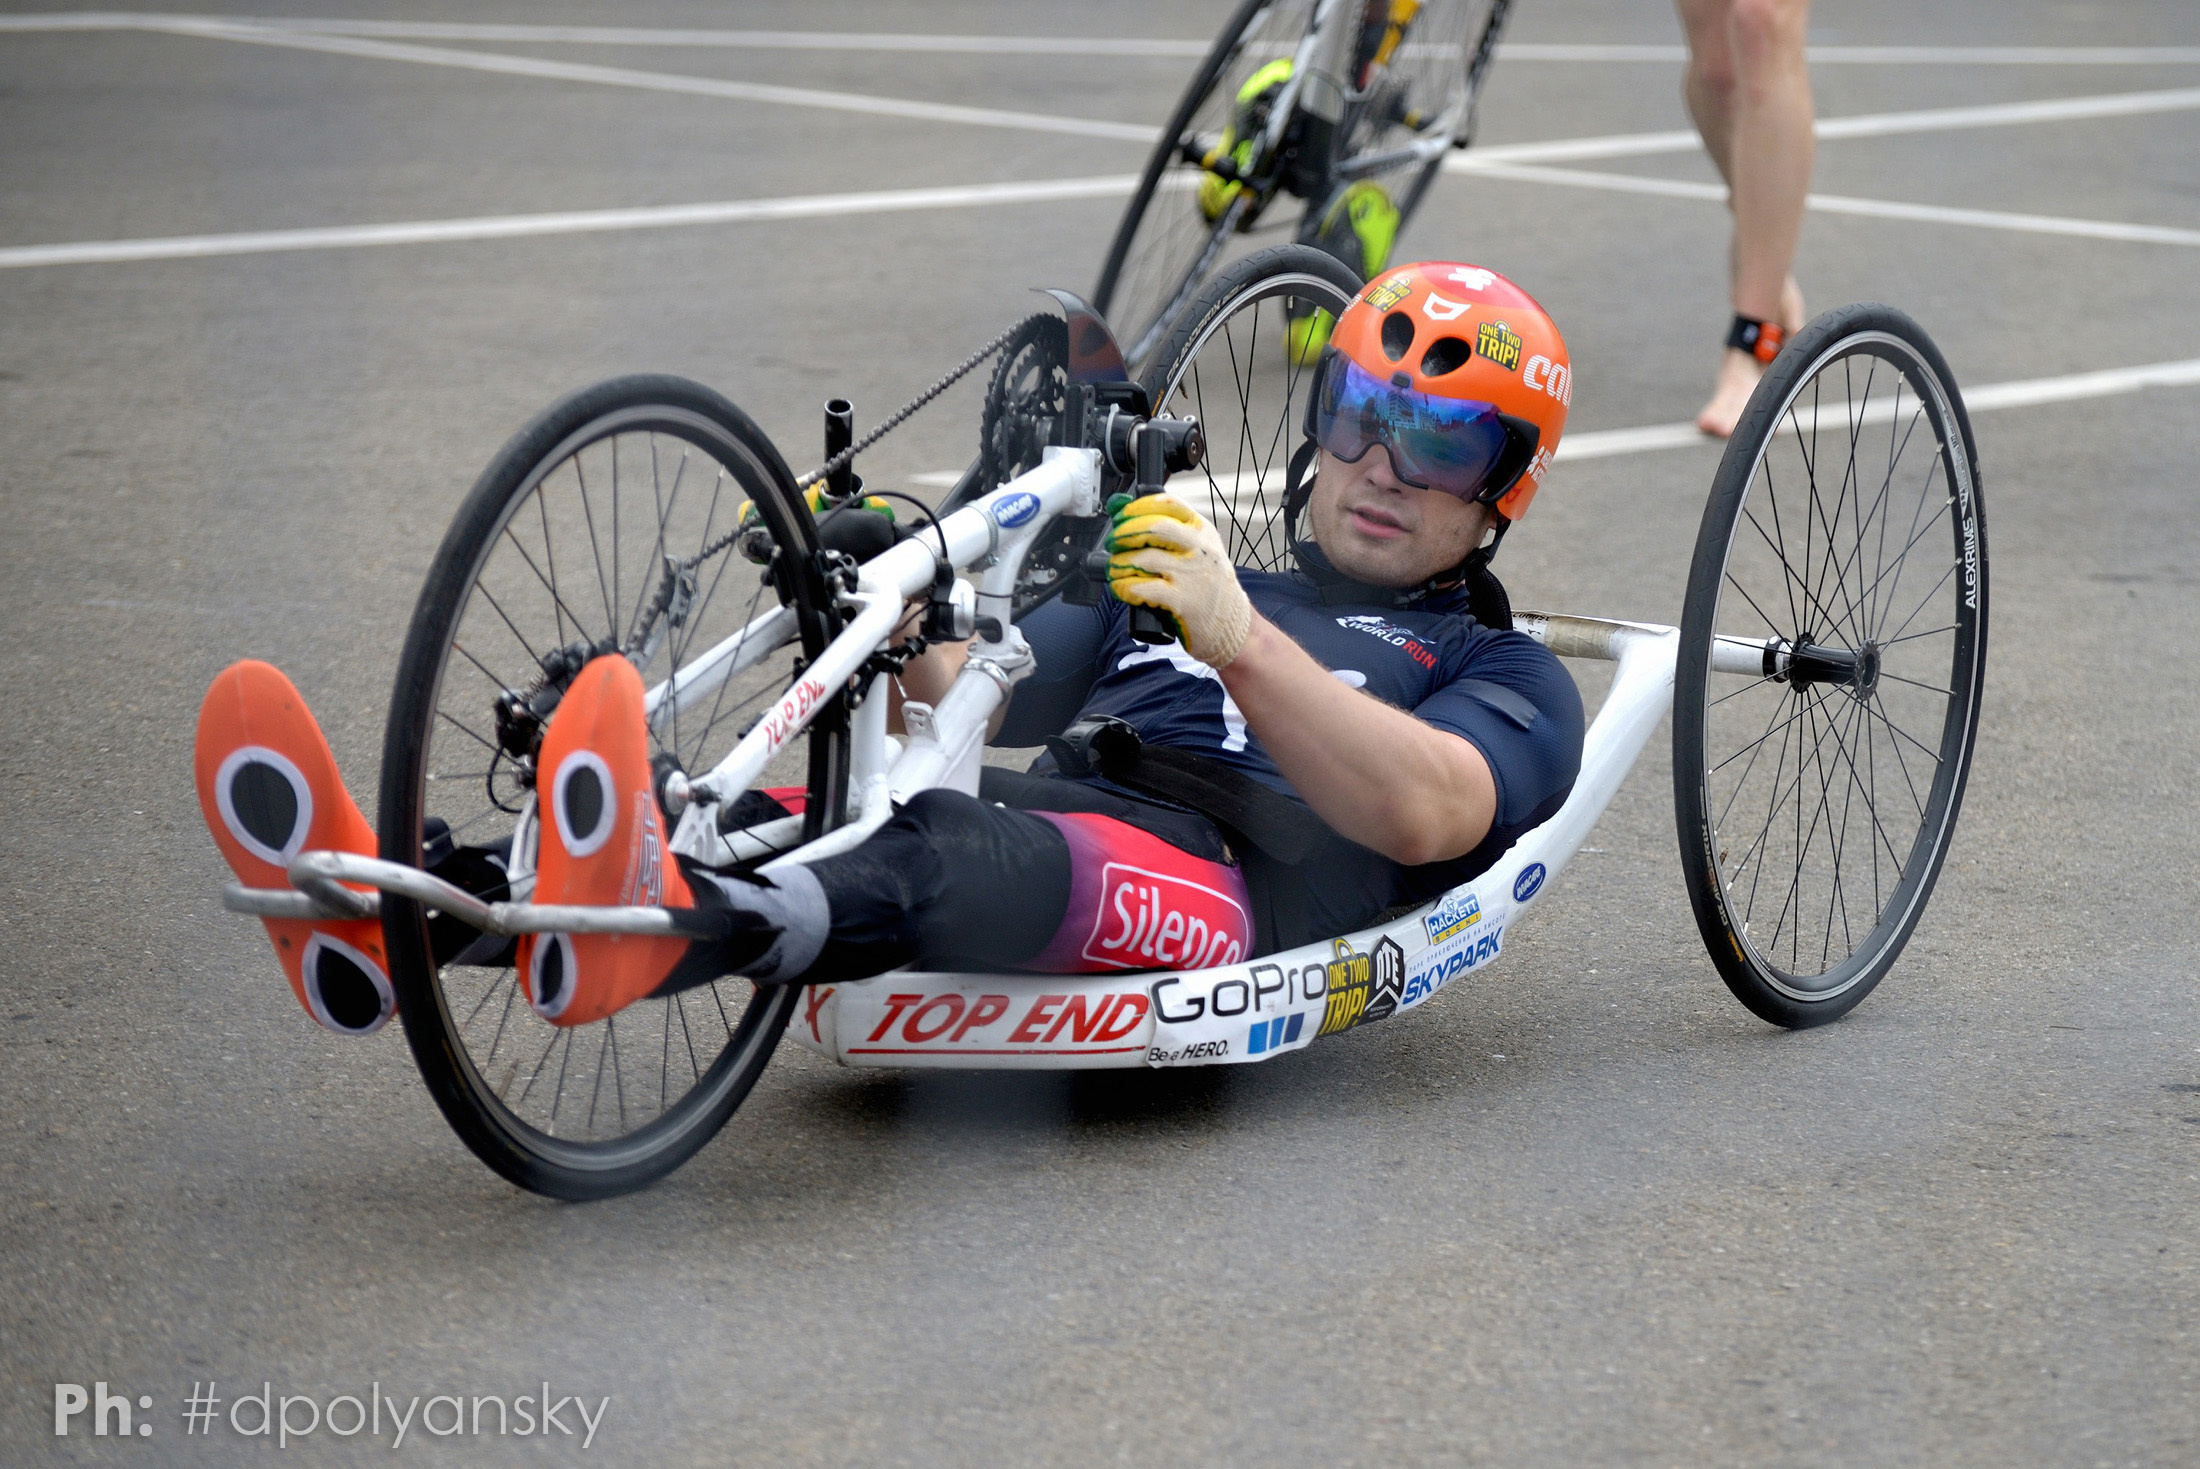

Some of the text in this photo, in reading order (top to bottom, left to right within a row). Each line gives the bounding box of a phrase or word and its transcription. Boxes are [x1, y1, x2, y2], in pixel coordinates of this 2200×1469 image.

[1479, 334, 1519, 370] TRIP!
[1480, 323, 1521, 349] ONE TWO
[1349, 621, 1407, 646] WORLD
[1402, 640, 1438, 670] RUN
[1430, 899, 1479, 934] HACKETT
[1328, 956, 1370, 990] ONE TWO
[1403, 926, 1503, 1005] SKYPARK
[1150, 963, 1327, 1024] GoPro
[1318, 985, 1369, 1036] TRIP!
[866, 994, 1150, 1044] TOP END
[1149, 1047, 1169, 1062] Be
